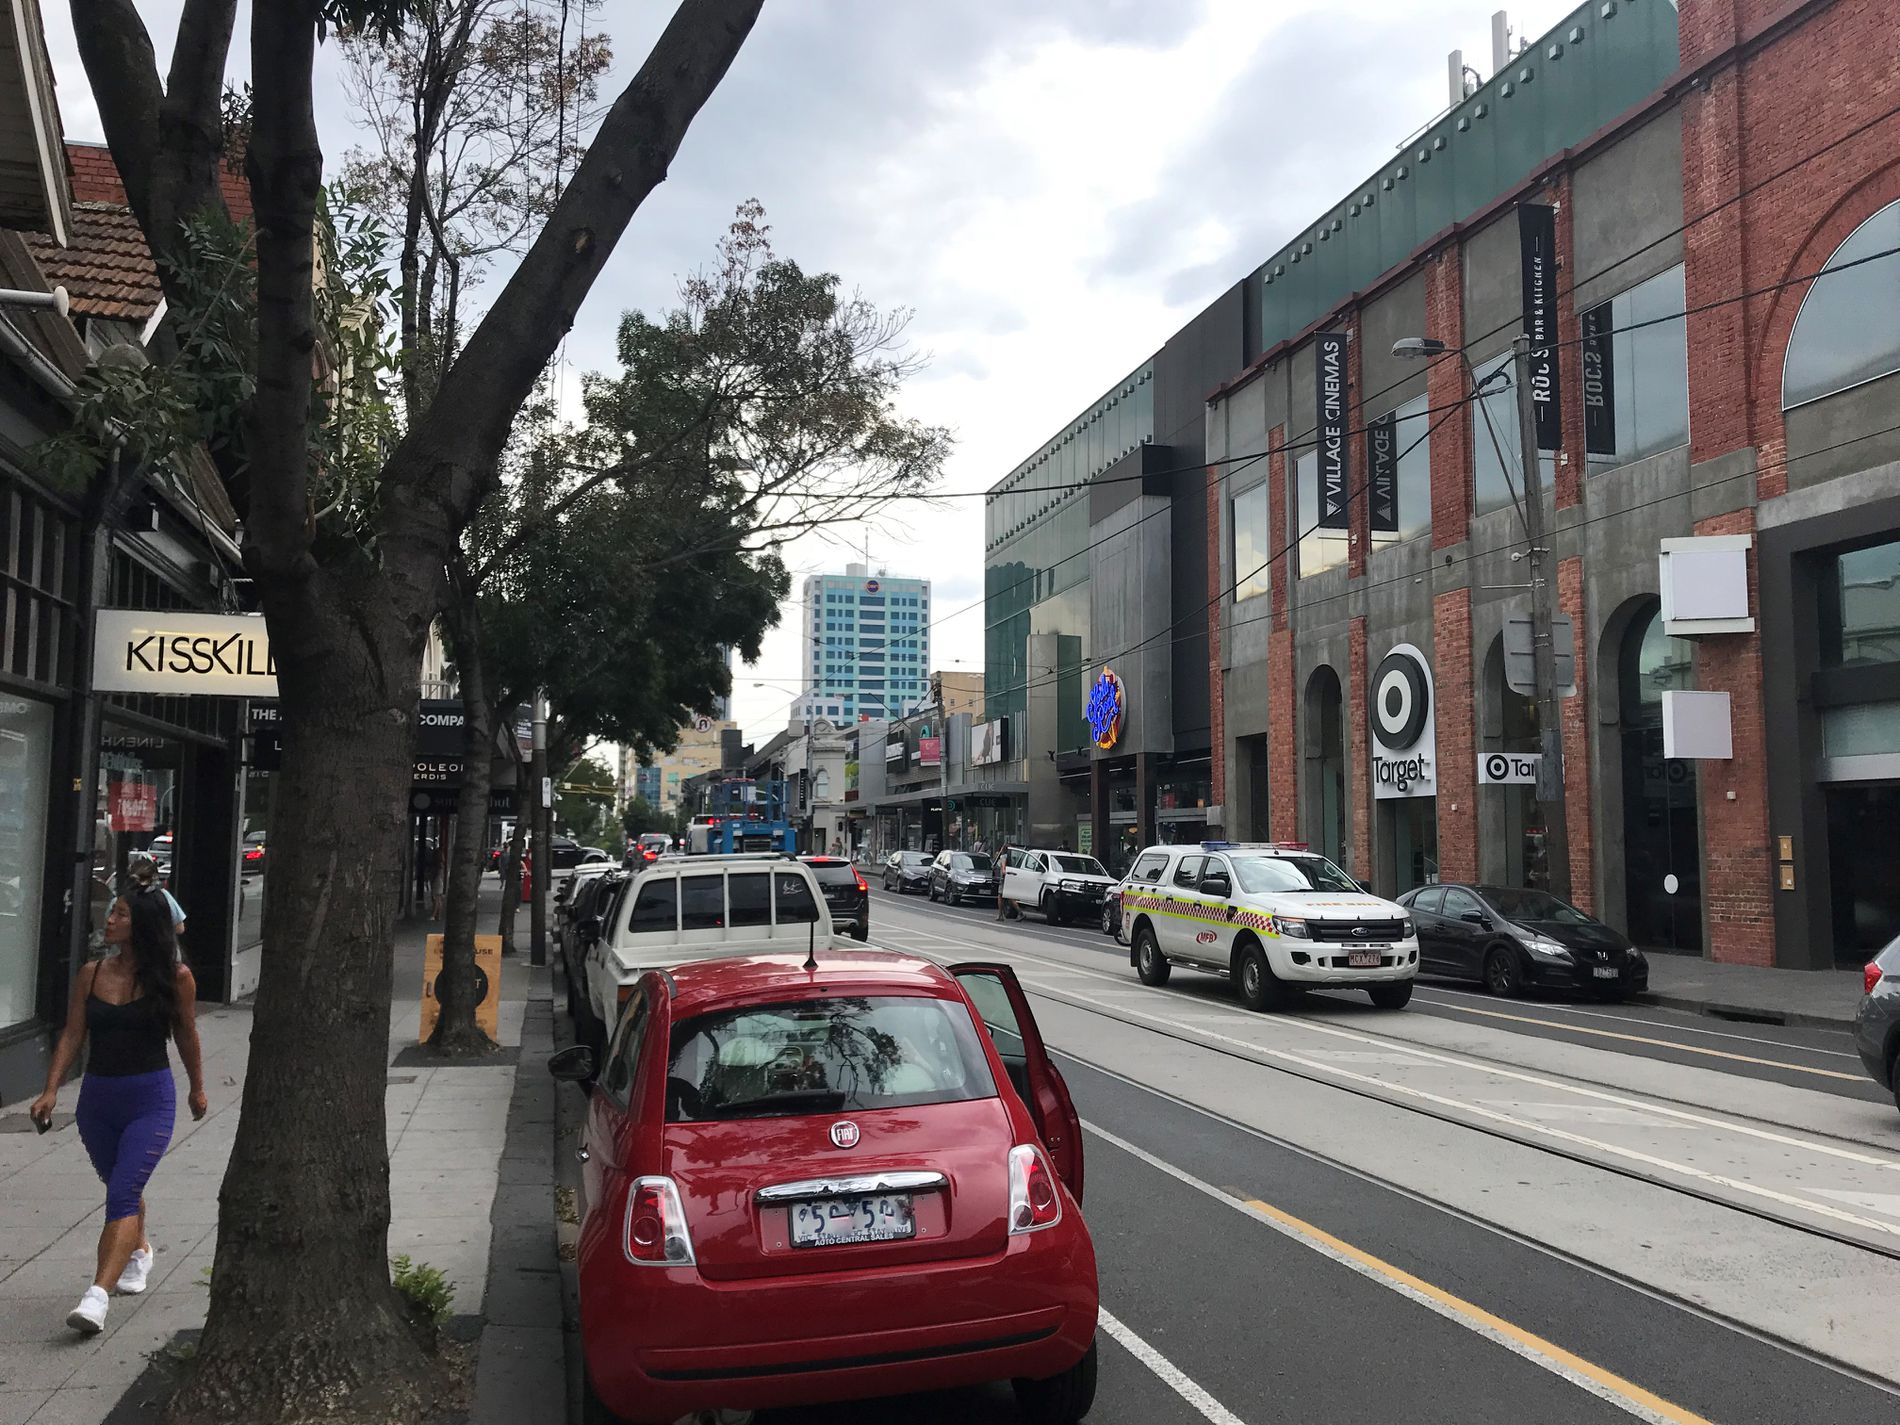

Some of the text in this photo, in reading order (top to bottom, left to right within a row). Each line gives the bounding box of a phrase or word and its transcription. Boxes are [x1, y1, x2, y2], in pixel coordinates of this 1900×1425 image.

[1534, 308, 1544, 316] &
[1534, 318, 1544, 341] BAR
[1324, 341, 1342, 497] VILLAGE CINEMAS
[252, 709, 277, 721] THE
[412, 763, 464, 772] OLEO
[1372, 753, 1425, 792] Target
[836, 1127, 854, 1140] FIAT
[814, 1237, 836, 1247] AUTO
[836, 1235, 869, 1245] CENTRAL
[871, 1232, 894, 1242] SALES
